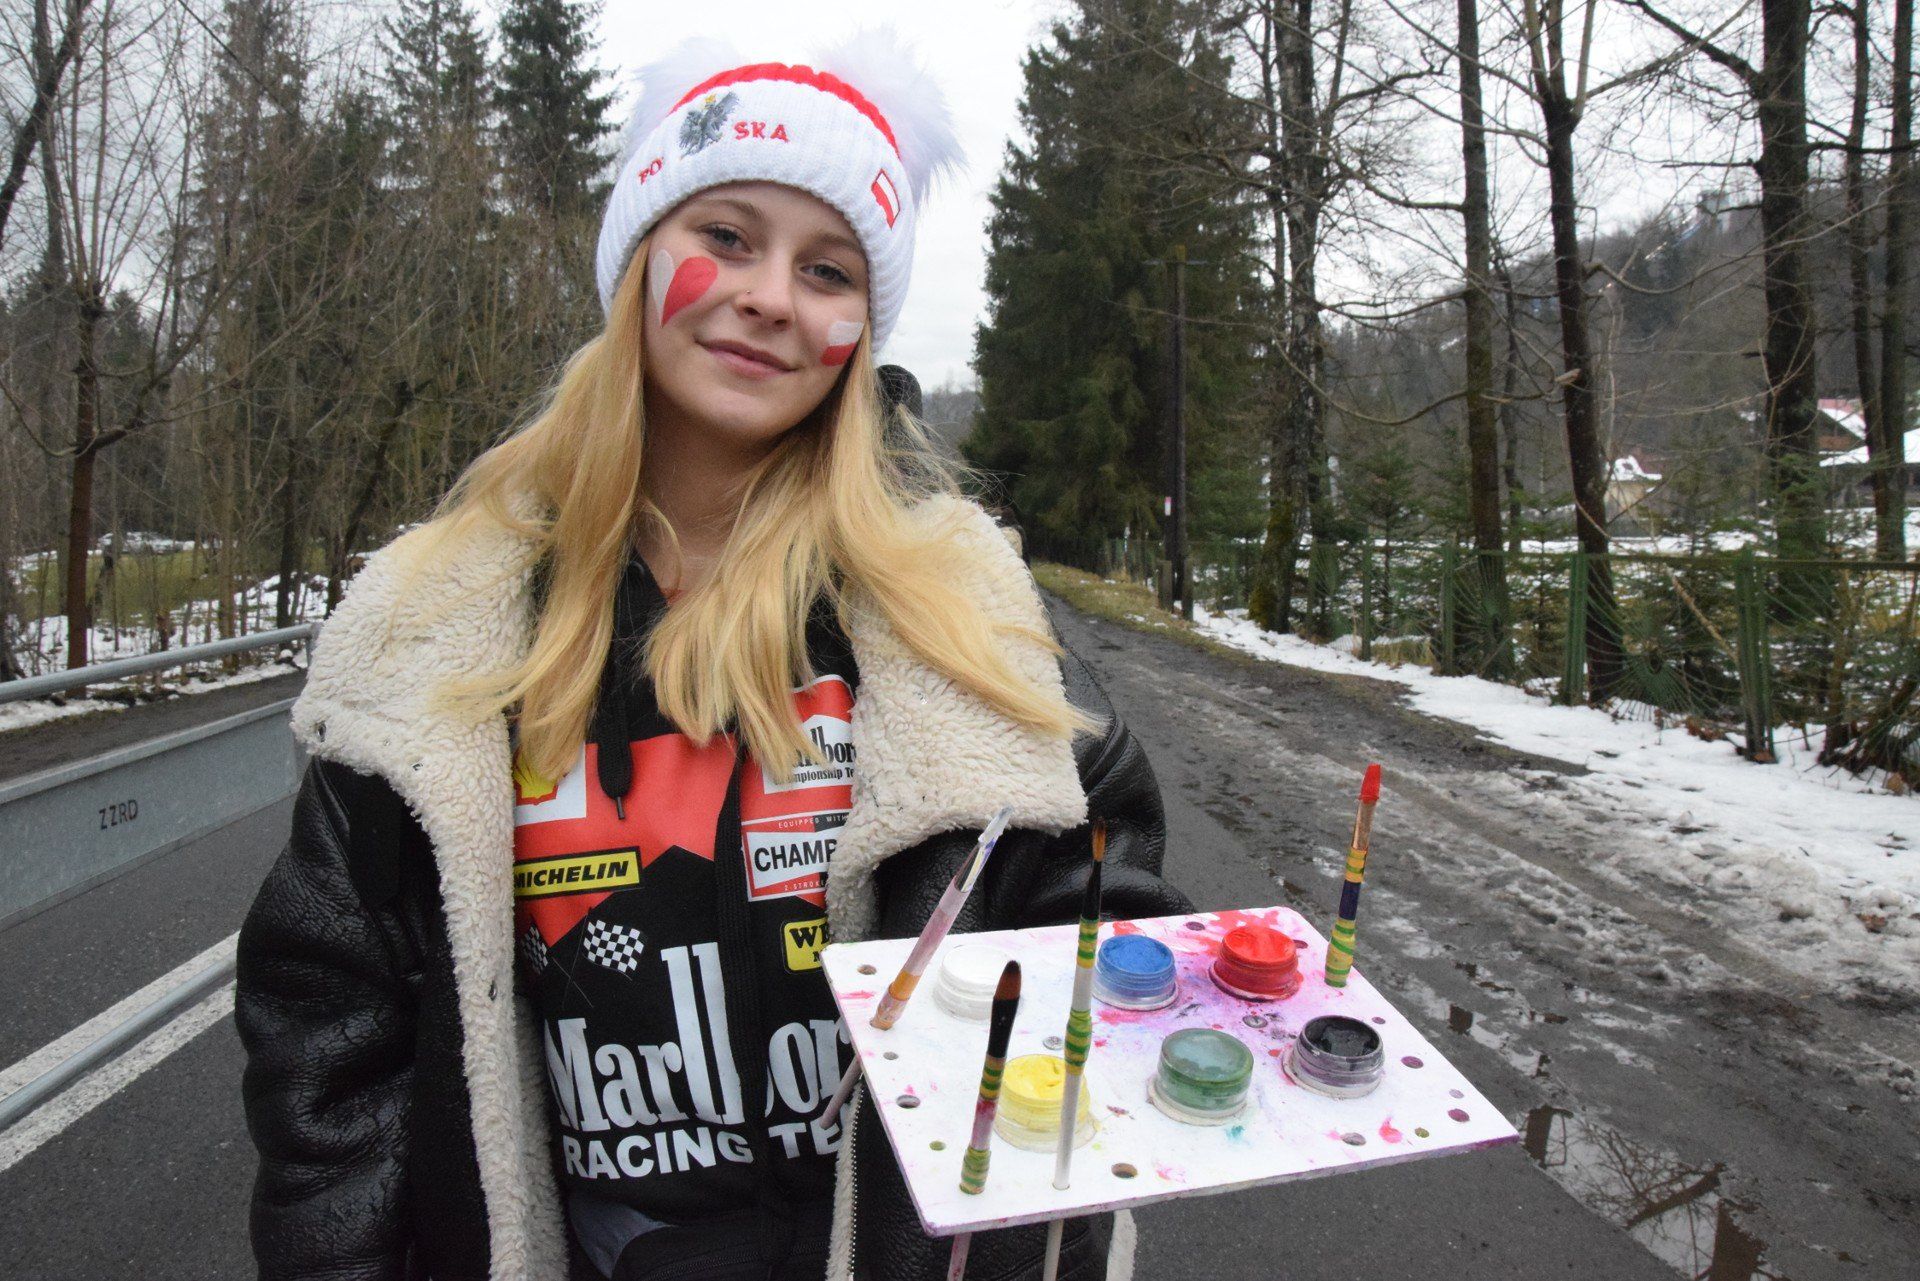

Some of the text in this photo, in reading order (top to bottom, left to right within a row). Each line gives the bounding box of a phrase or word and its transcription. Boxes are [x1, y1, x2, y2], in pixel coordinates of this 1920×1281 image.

[733, 119, 790, 143] SKA
[99, 800, 138, 830] ZZRD
[778, 817, 820, 829] EQUIPPED
[754, 838, 837, 872] CHAMP
[563, 1127, 754, 1180] RACING
